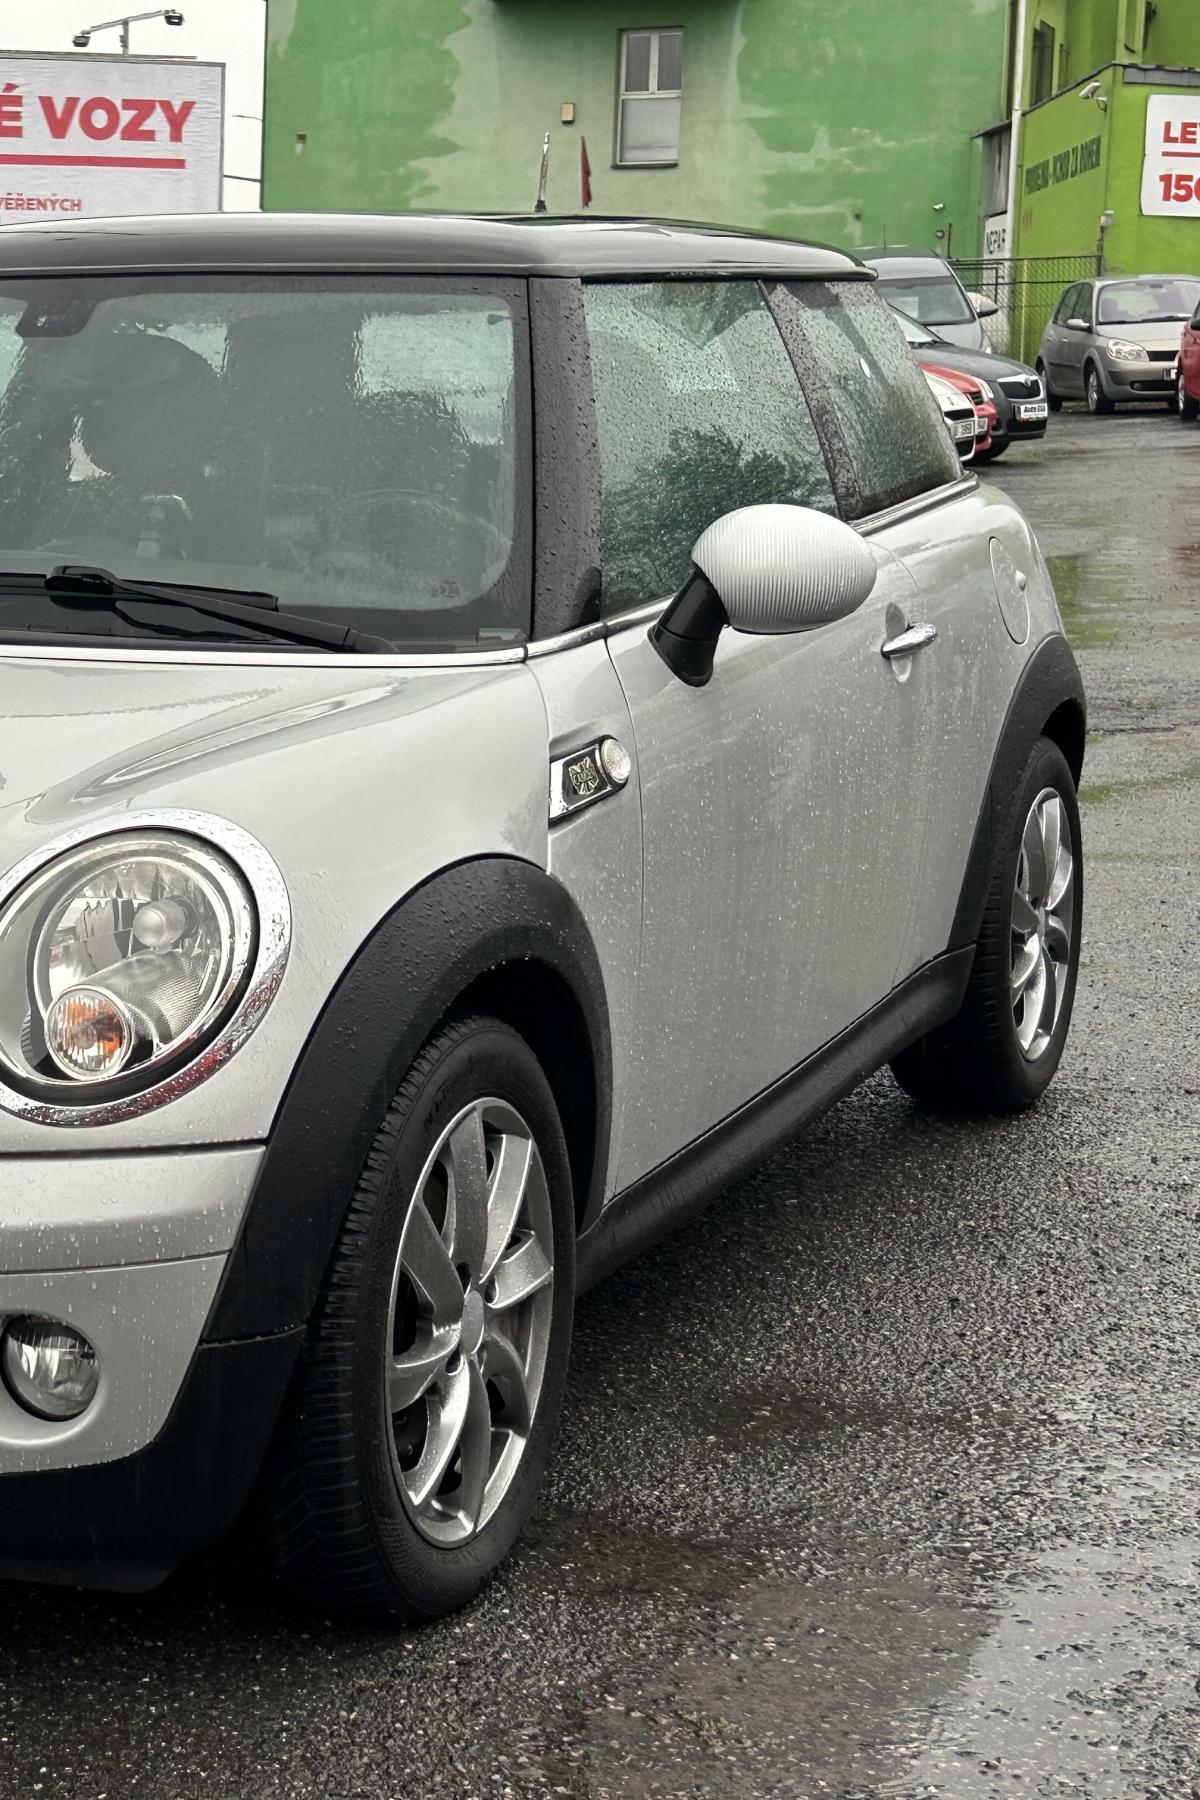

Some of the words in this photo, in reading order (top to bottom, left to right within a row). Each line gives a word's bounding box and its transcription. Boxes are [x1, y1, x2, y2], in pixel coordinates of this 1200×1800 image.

[38, 97, 196, 142] VOZY
[1163, 121, 1200, 144] LE
[1159, 173, 1200, 203] 15
